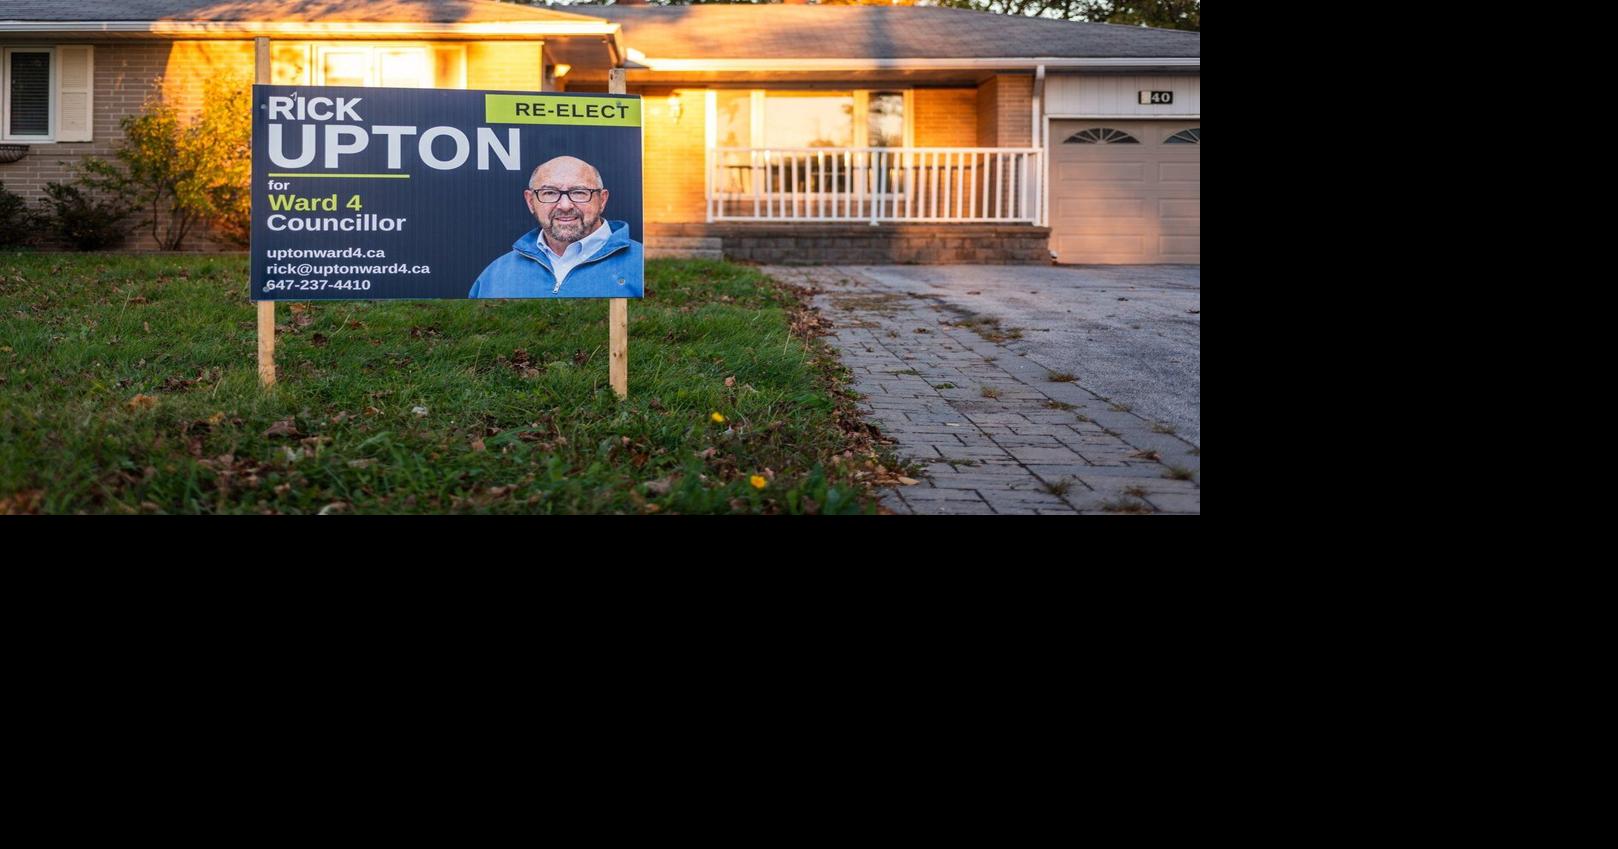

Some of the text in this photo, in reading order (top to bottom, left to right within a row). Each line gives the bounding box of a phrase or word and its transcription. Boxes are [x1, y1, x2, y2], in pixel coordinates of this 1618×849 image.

[268, 96, 363, 121] RICK
[515, 101, 630, 120] RE-ELECT
[268, 124, 521, 170] UPTON
[267, 179, 290, 191] for
[268, 193, 363, 212] Ward 4
[266, 213, 407, 232] Councillor
[266, 247, 386, 260] uptonward4.ca
[266, 262, 431, 276] rick@uptonward4.ca
[266, 279, 371, 291] 647-237-4410
